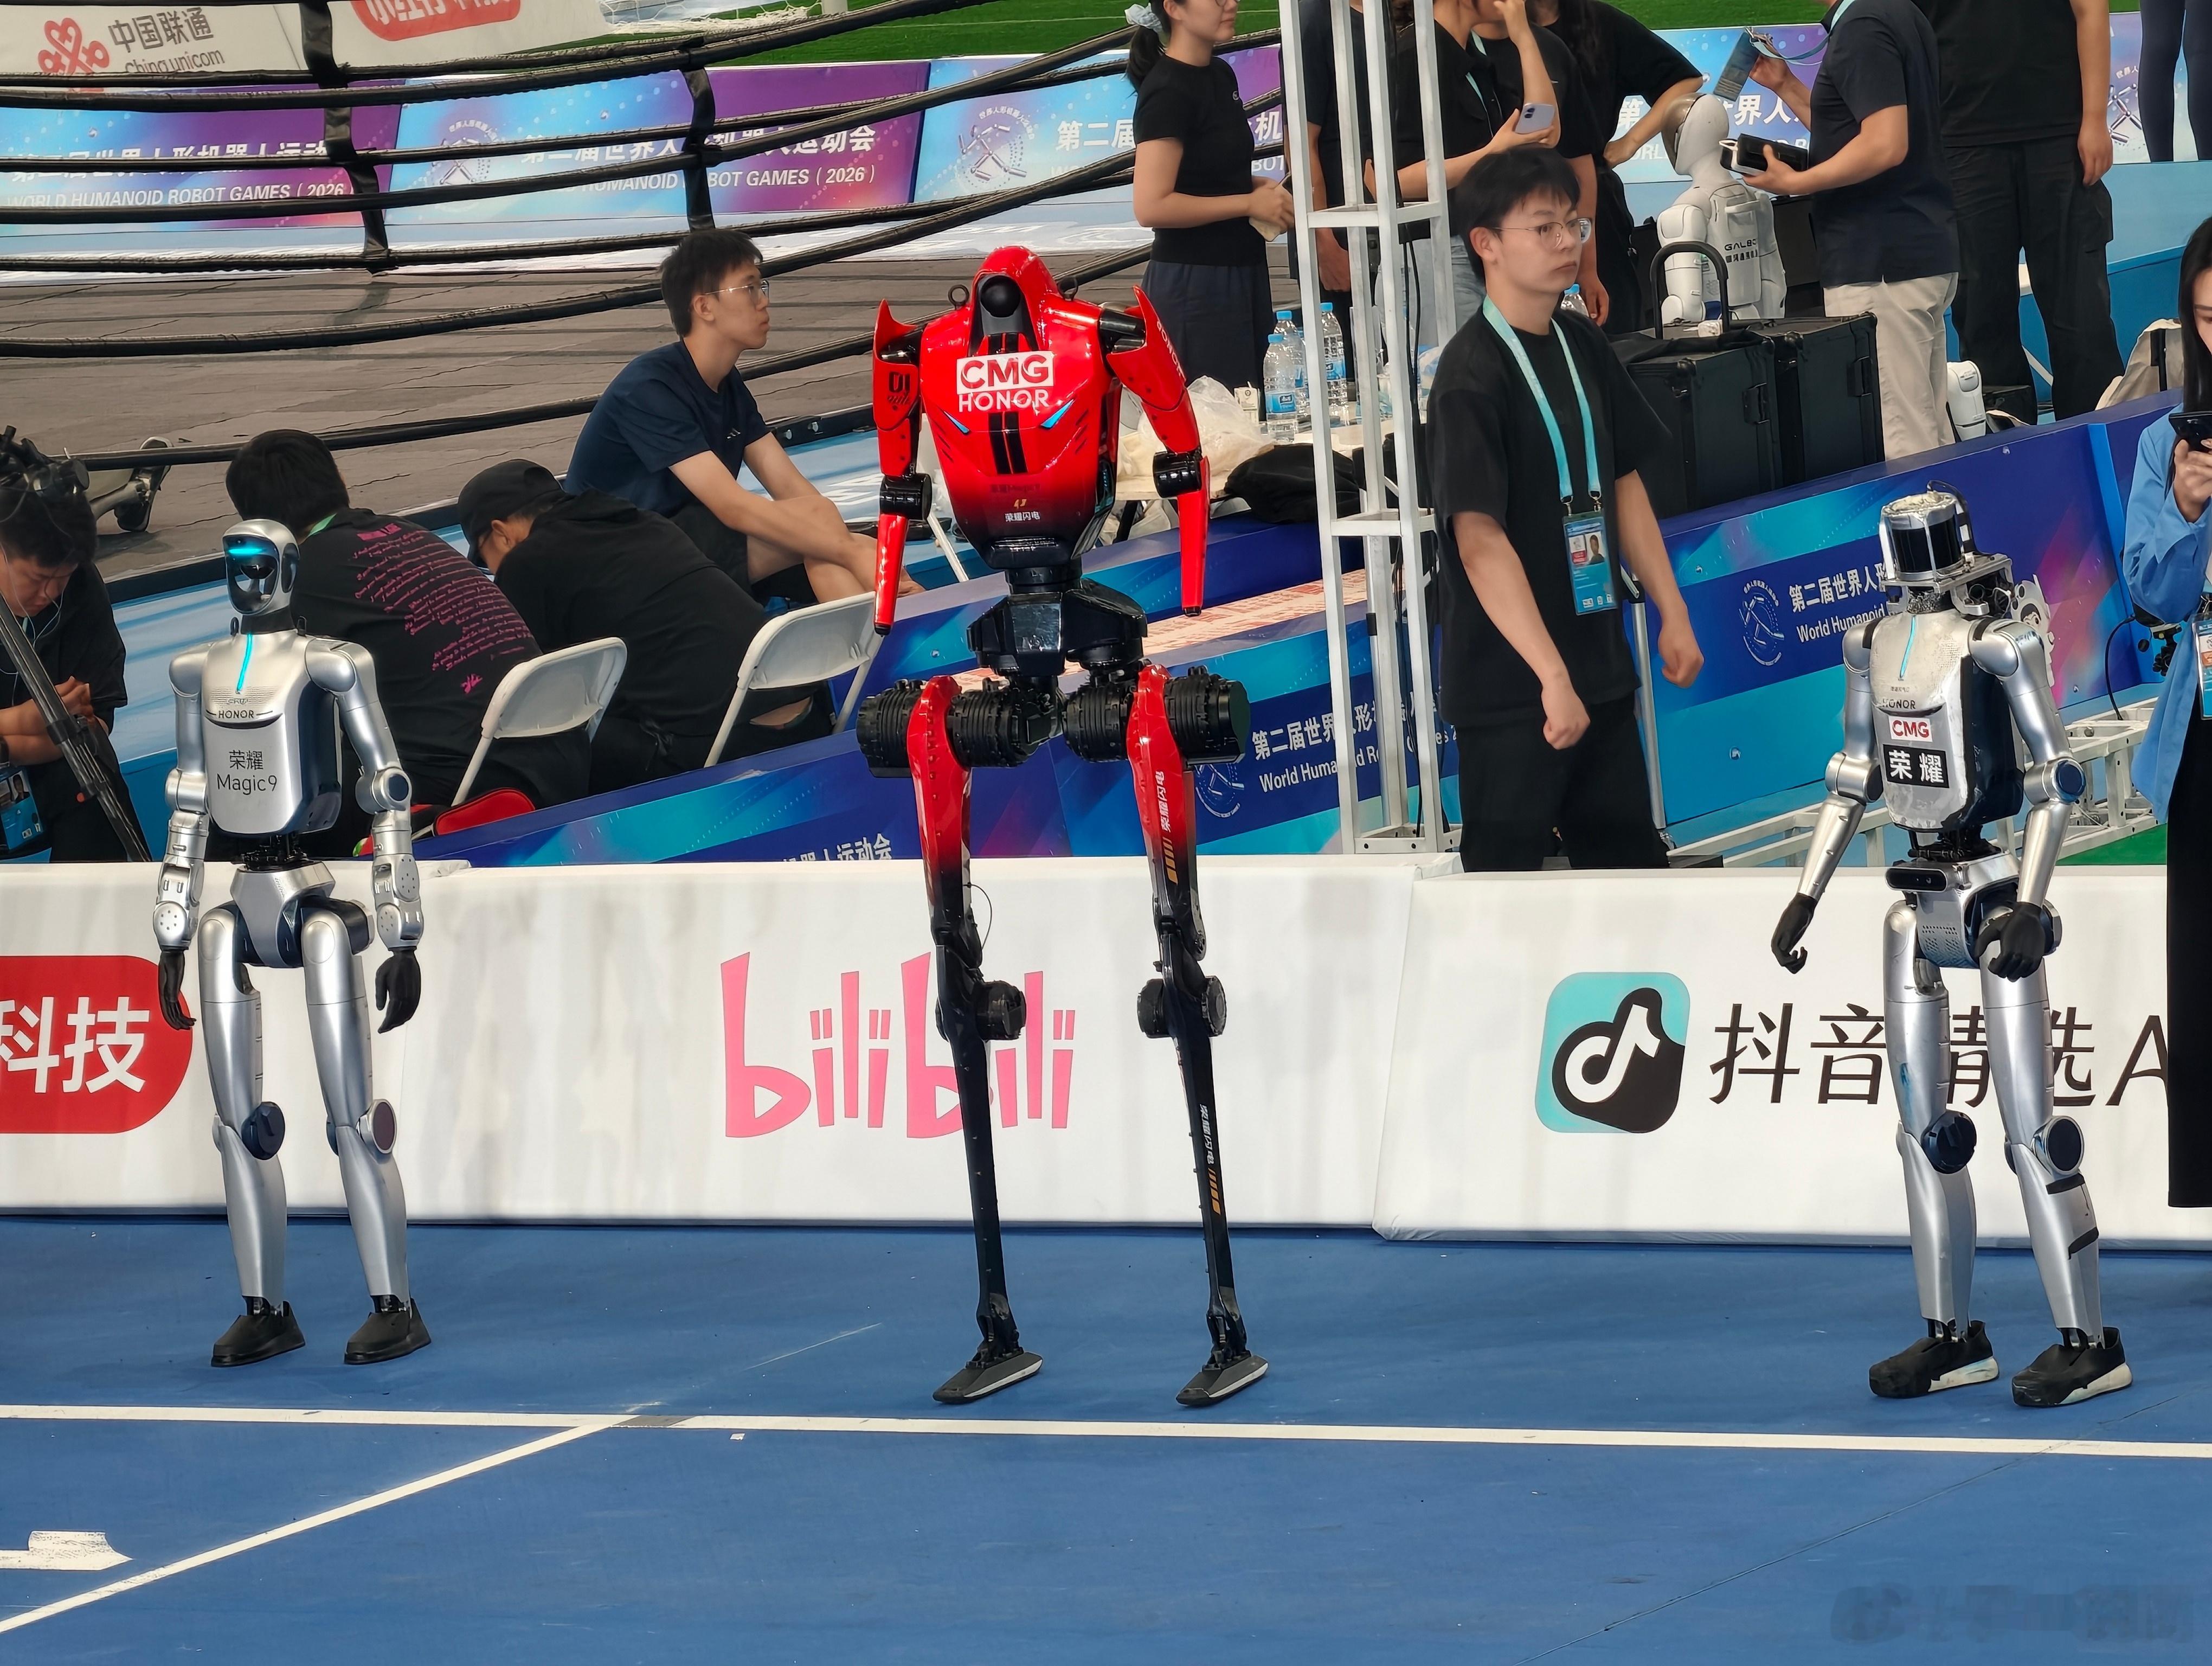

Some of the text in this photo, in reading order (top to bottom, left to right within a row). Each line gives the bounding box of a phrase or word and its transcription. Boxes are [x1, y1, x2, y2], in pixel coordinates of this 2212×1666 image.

[108, 7, 214, 53] 中国联通
[1724, 95, 1791, 126] 界人
[746, 169, 809, 186] GAMES
[71, 190, 163, 207] HUMANOID
[168, 187, 226, 205] ROBOT
[229, 184, 291, 202] GAMES
[960, 354, 1049, 389] CMG
[959, 389, 1050, 412] HONOR
[1796, 603, 1885, 643] World Humanoid
[218, 710, 254, 719] HONOR
[1892, 720, 1930, 738] CMG
[229, 749, 264, 771] 荣耀
[1259, 765, 1300, 793] World
[1300, 747, 1366, 782] Humad
[1888, 749, 1945, 784] 荣耀
[721, 952, 1075, 1139] bilibili
